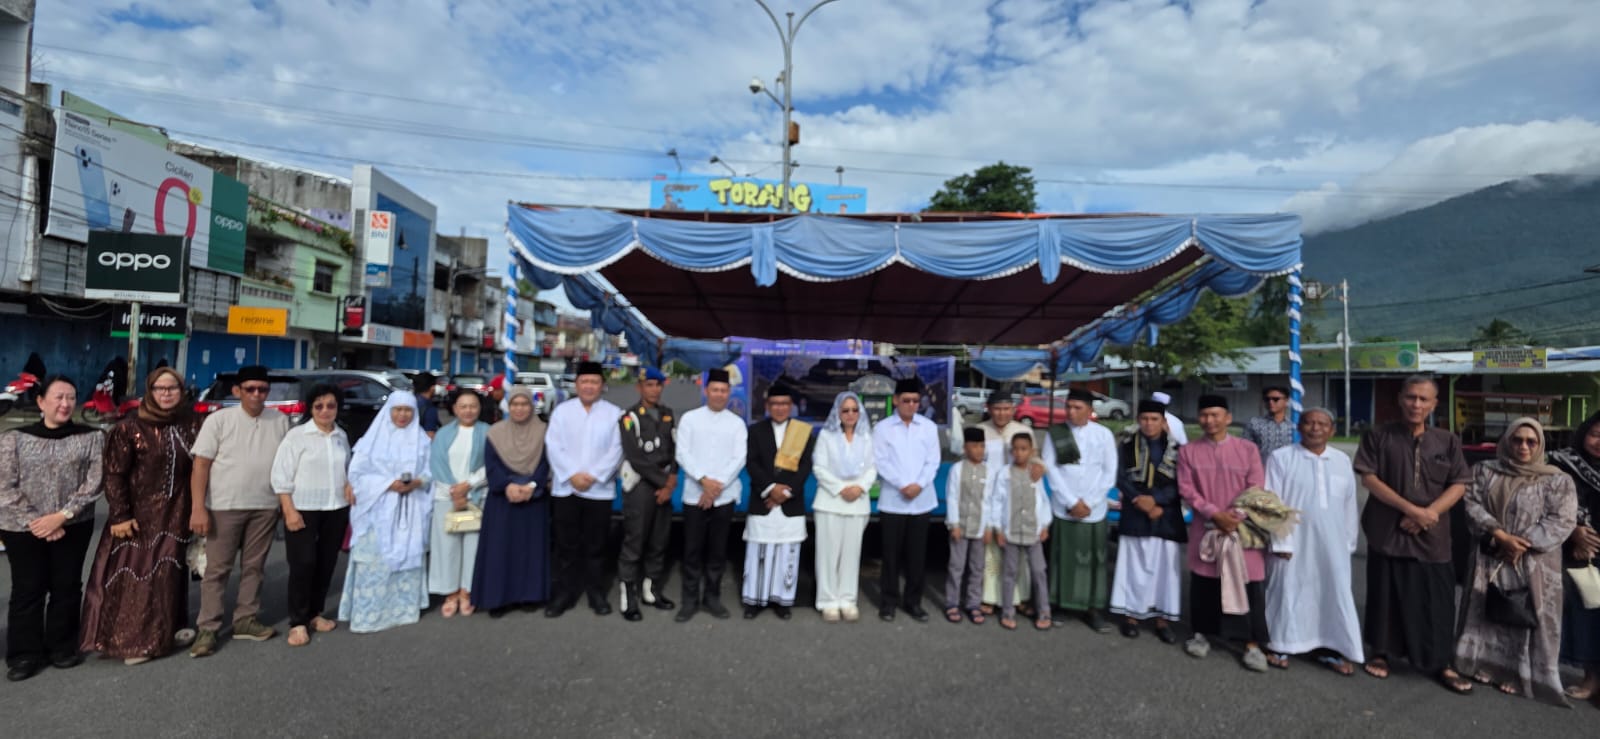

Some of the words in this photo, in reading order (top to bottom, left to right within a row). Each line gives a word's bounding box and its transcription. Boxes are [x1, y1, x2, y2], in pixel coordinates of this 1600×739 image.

[214, 214, 244, 232] oppo
[370, 230, 389, 240] BNI
[98, 251, 171, 272] oppo
